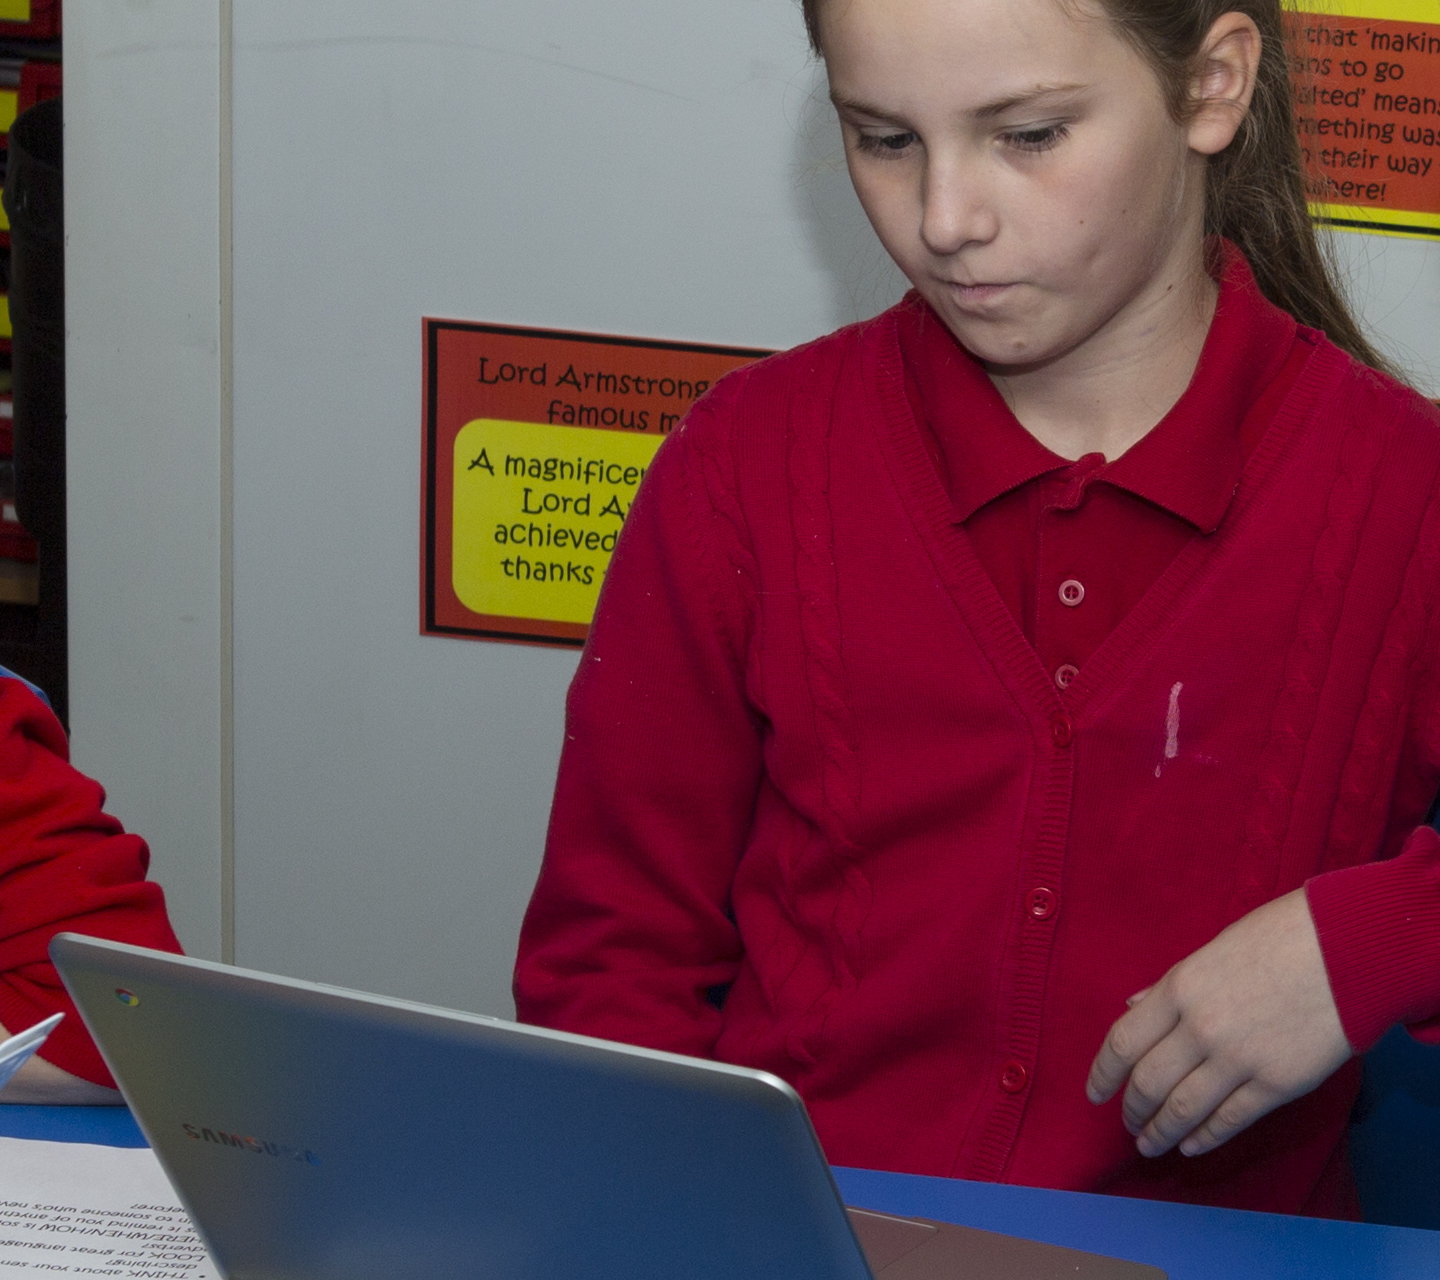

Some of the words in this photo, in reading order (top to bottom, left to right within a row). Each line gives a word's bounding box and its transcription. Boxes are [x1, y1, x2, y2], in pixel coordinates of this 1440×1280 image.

[1306, 24, 1358, 46] that
[1375, 62, 1404, 82] go
[1320, 149, 1379, 169] their
[1388, 156, 1432, 177] way
[478, 357, 547, 386] Lord
[555, 365, 710, 400] Armstrong
[547, 399, 649, 430] famous
[467, 448, 495, 476] A
[521, 487, 591, 517] Lord
[494, 523, 618, 552] achieved
[500, 555, 595, 585] thanks
[81, 1208, 152, 1220] someone
[32, 1263, 67, 1272] your
[105, 1260, 198, 1270] describing?
[148, 1252, 206, 1261] LOOK
[73, 1267, 122, 1276] about
[126, 1269, 189, 1279] THINK
